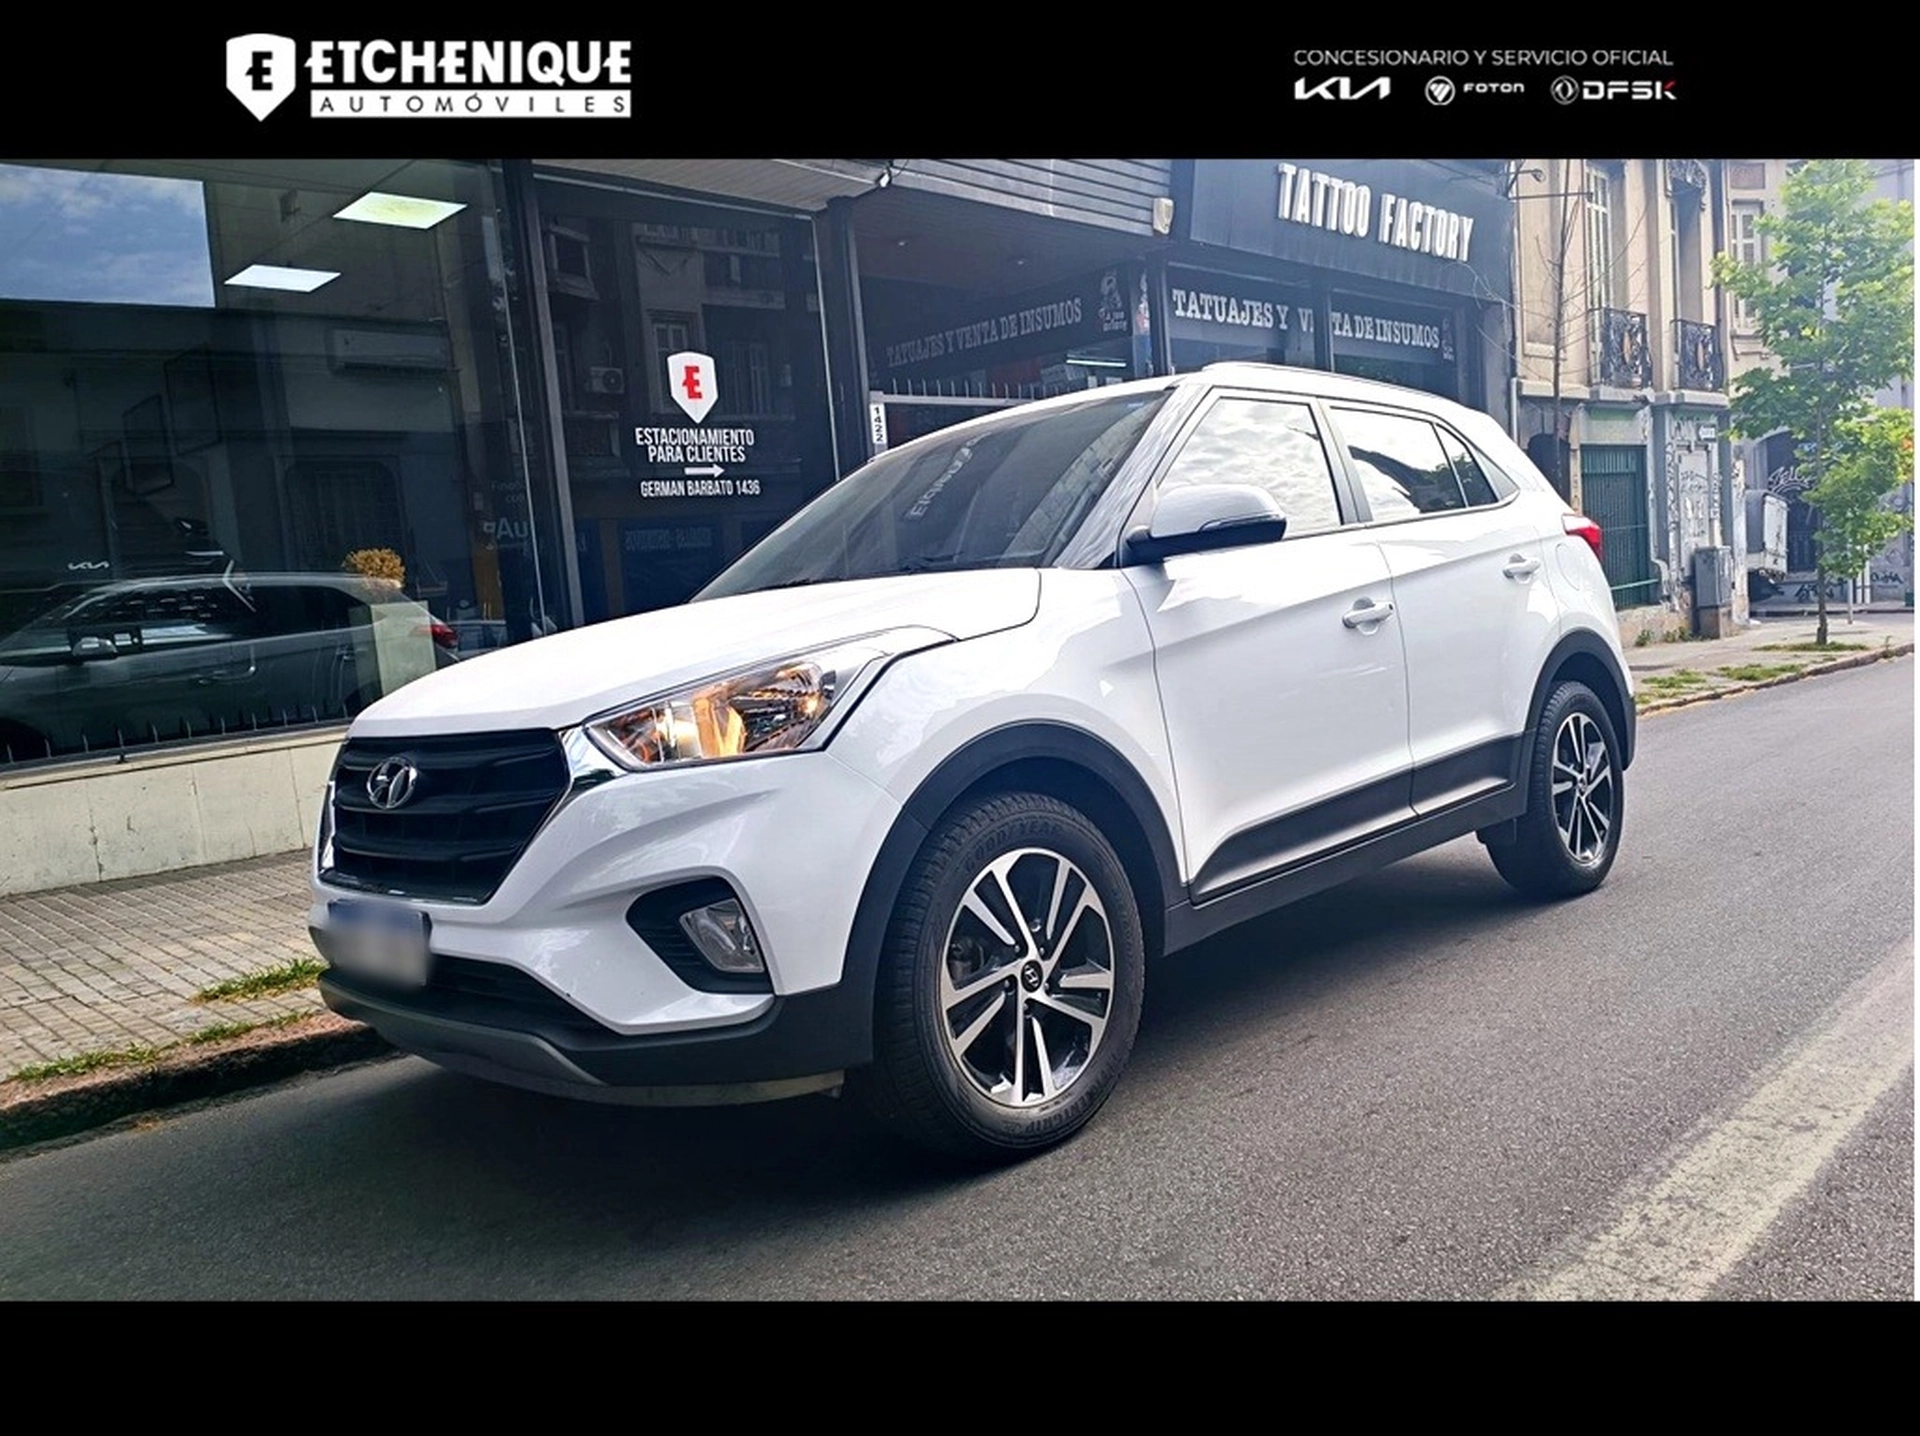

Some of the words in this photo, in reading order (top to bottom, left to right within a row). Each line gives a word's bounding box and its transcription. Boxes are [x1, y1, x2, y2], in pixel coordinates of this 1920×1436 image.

[1278, 163, 1371, 238] TATTOO
[1377, 194, 1474, 262] FACTORY
[887, 331, 945, 367] TATUAJES
[945, 331, 955, 352] Y
[954, 319, 998, 349] VENTA
[1000, 314, 1019, 340] DE
[1019, 298, 1081, 334] INSUMOS
[1172, 289, 1274, 327] TATUAJES
[1276, 305, 1289, 331] Y
[1354, 315, 1374, 339] DE
[1375, 317, 1440, 349] INSUMOS
[635, 427, 755, 446] ESTACIONAMIENTO
[872, 406, 884, 442] 1422
[648, 445, 685, 462] PARA
[686, 445, 746, 462] CLIENTES
[640, 480, 685, 497] GERMAN
[686, 480, 734, 496] BARBATO
[736, 479, 760, 496] 1436
